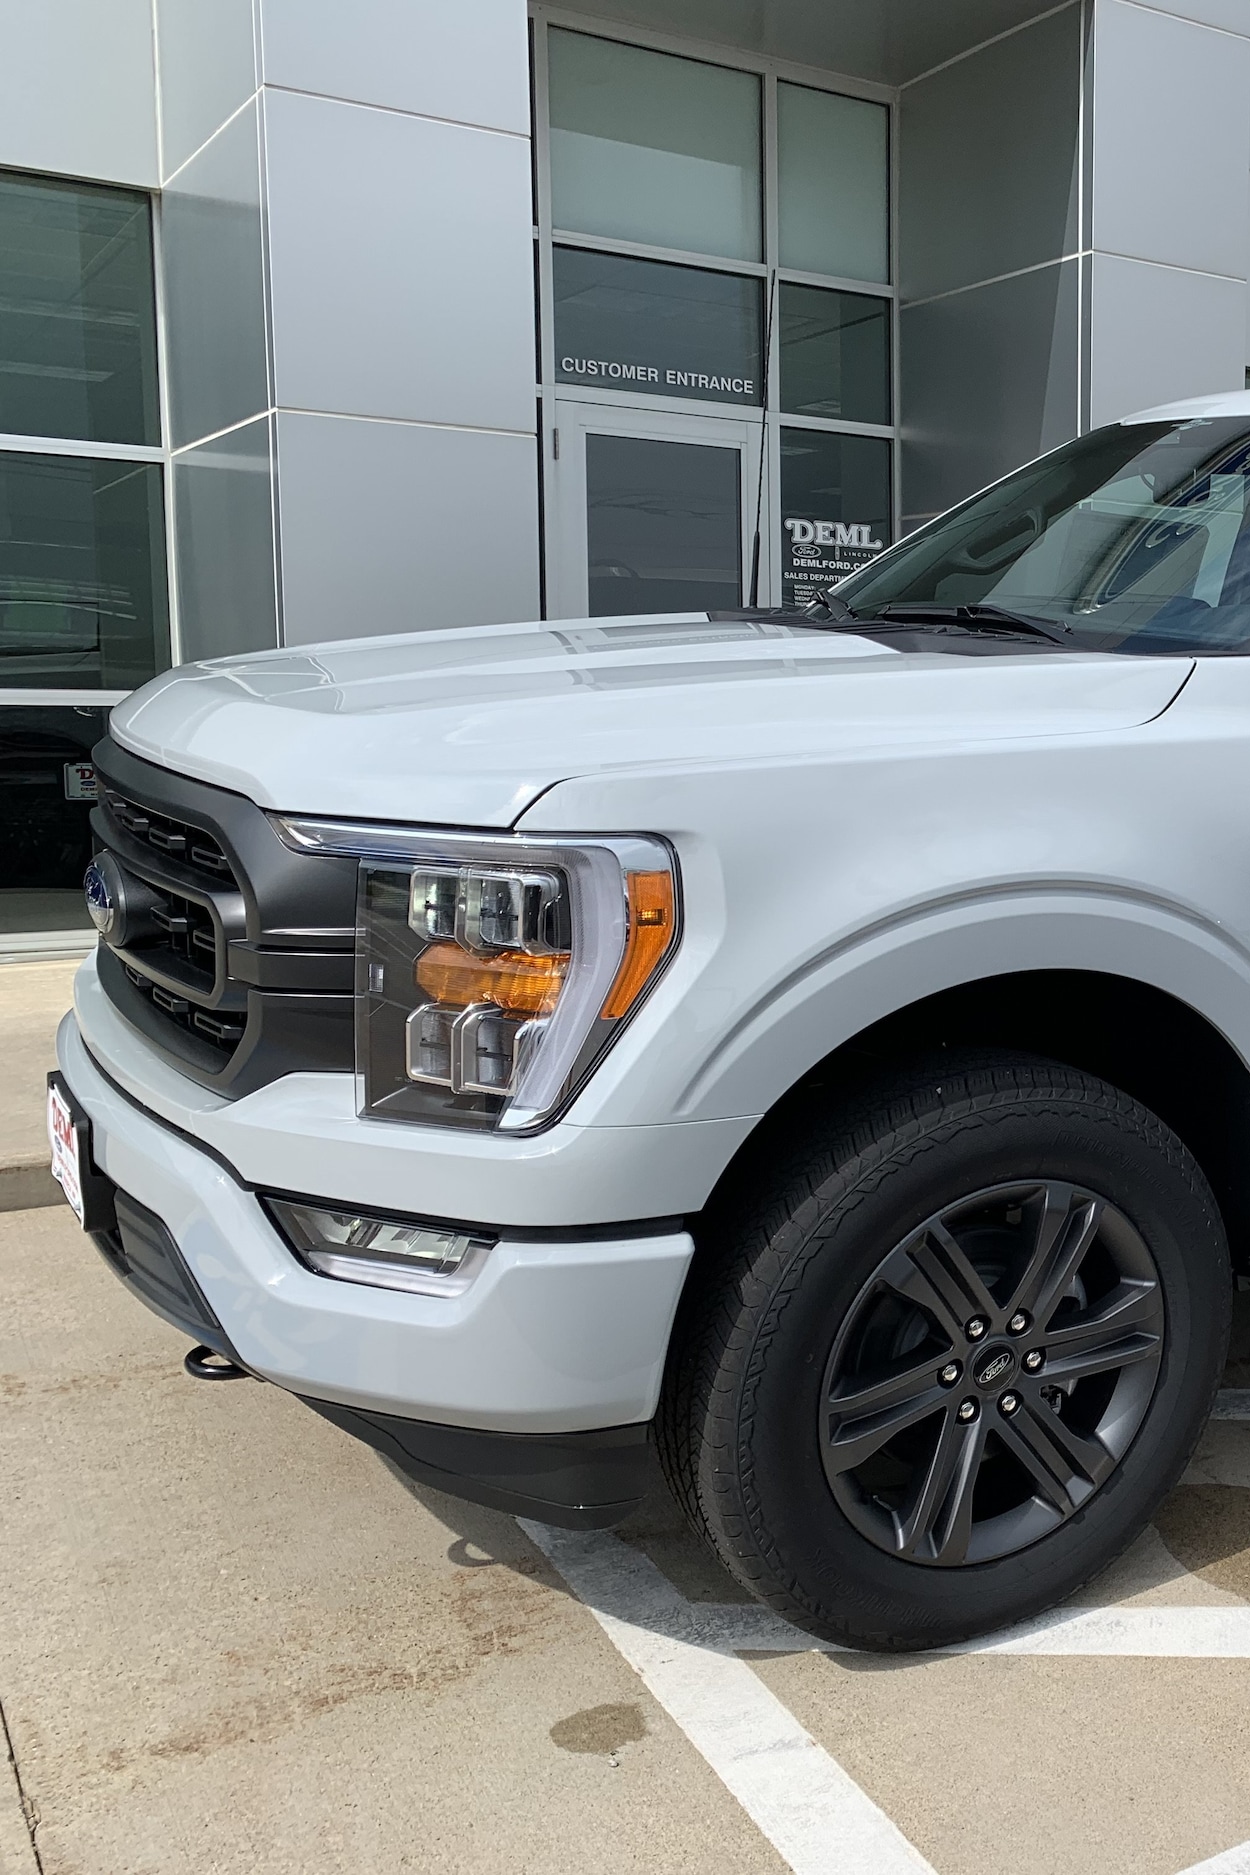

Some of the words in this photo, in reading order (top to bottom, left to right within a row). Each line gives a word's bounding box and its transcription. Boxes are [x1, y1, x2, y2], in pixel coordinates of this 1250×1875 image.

[561, 357, 659, 382] CUSTOMER
[666, 370, 754, 394] ENTRANCE
[784, 518, 883, 550] DEML
[784, 572, 808, 580] SALES
